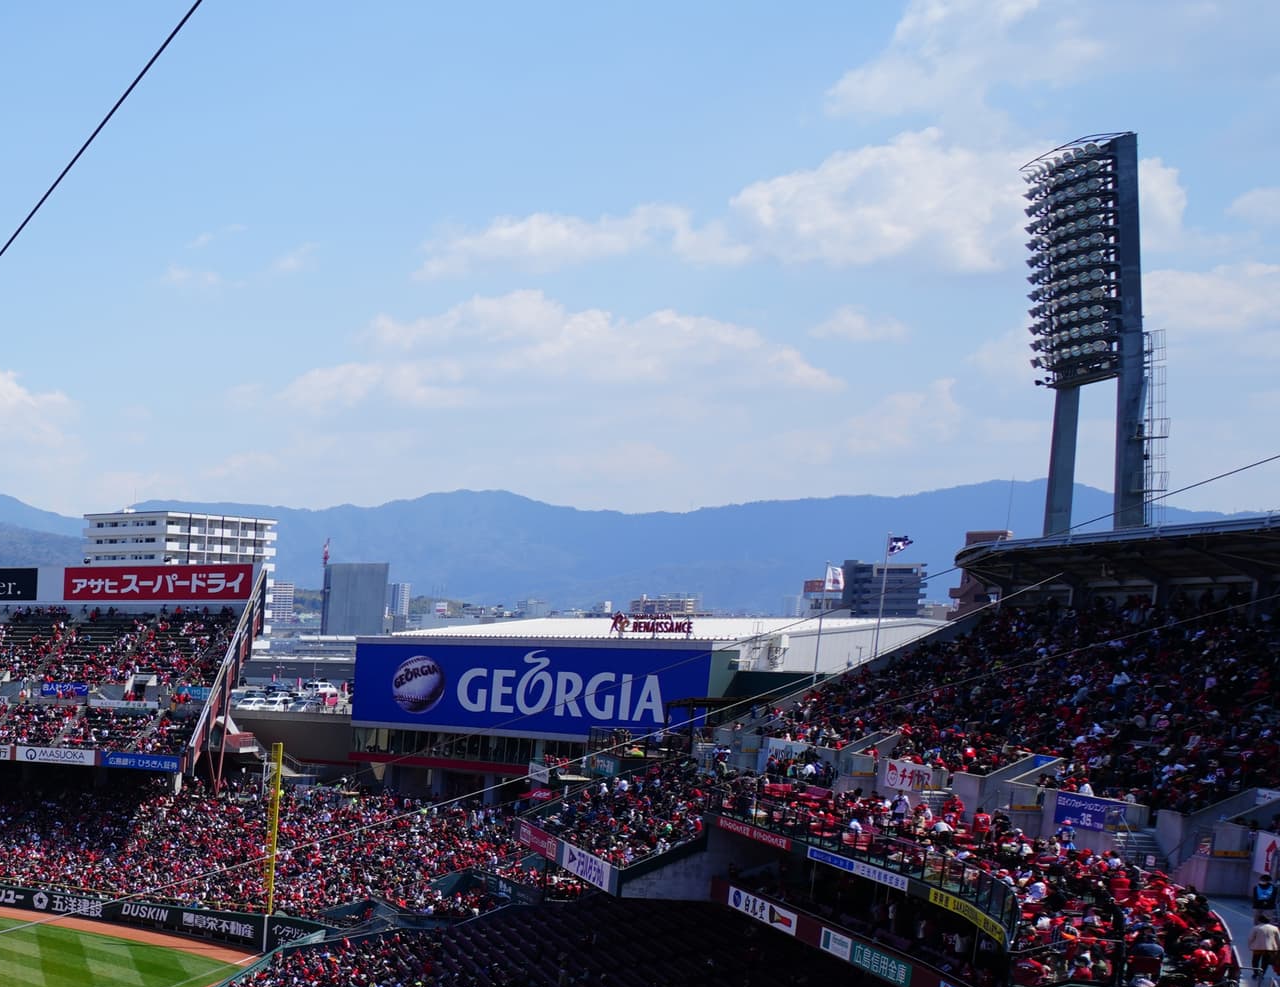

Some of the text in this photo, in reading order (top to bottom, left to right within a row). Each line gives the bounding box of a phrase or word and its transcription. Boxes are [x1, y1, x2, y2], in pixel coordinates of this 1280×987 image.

[632, 621, 694, 634] RENAISSANCE
[393, 664, 439, 689] GEORGIA
[456, 649, 665, 724] GEORGIA
[38, 750, 85, 760] MASUOKA
[51, 896, 103, 919] 五洋建設
[121, 903, 169, 923] DUSKIN
[853, 942, 908, 985] 広島信用金庫
